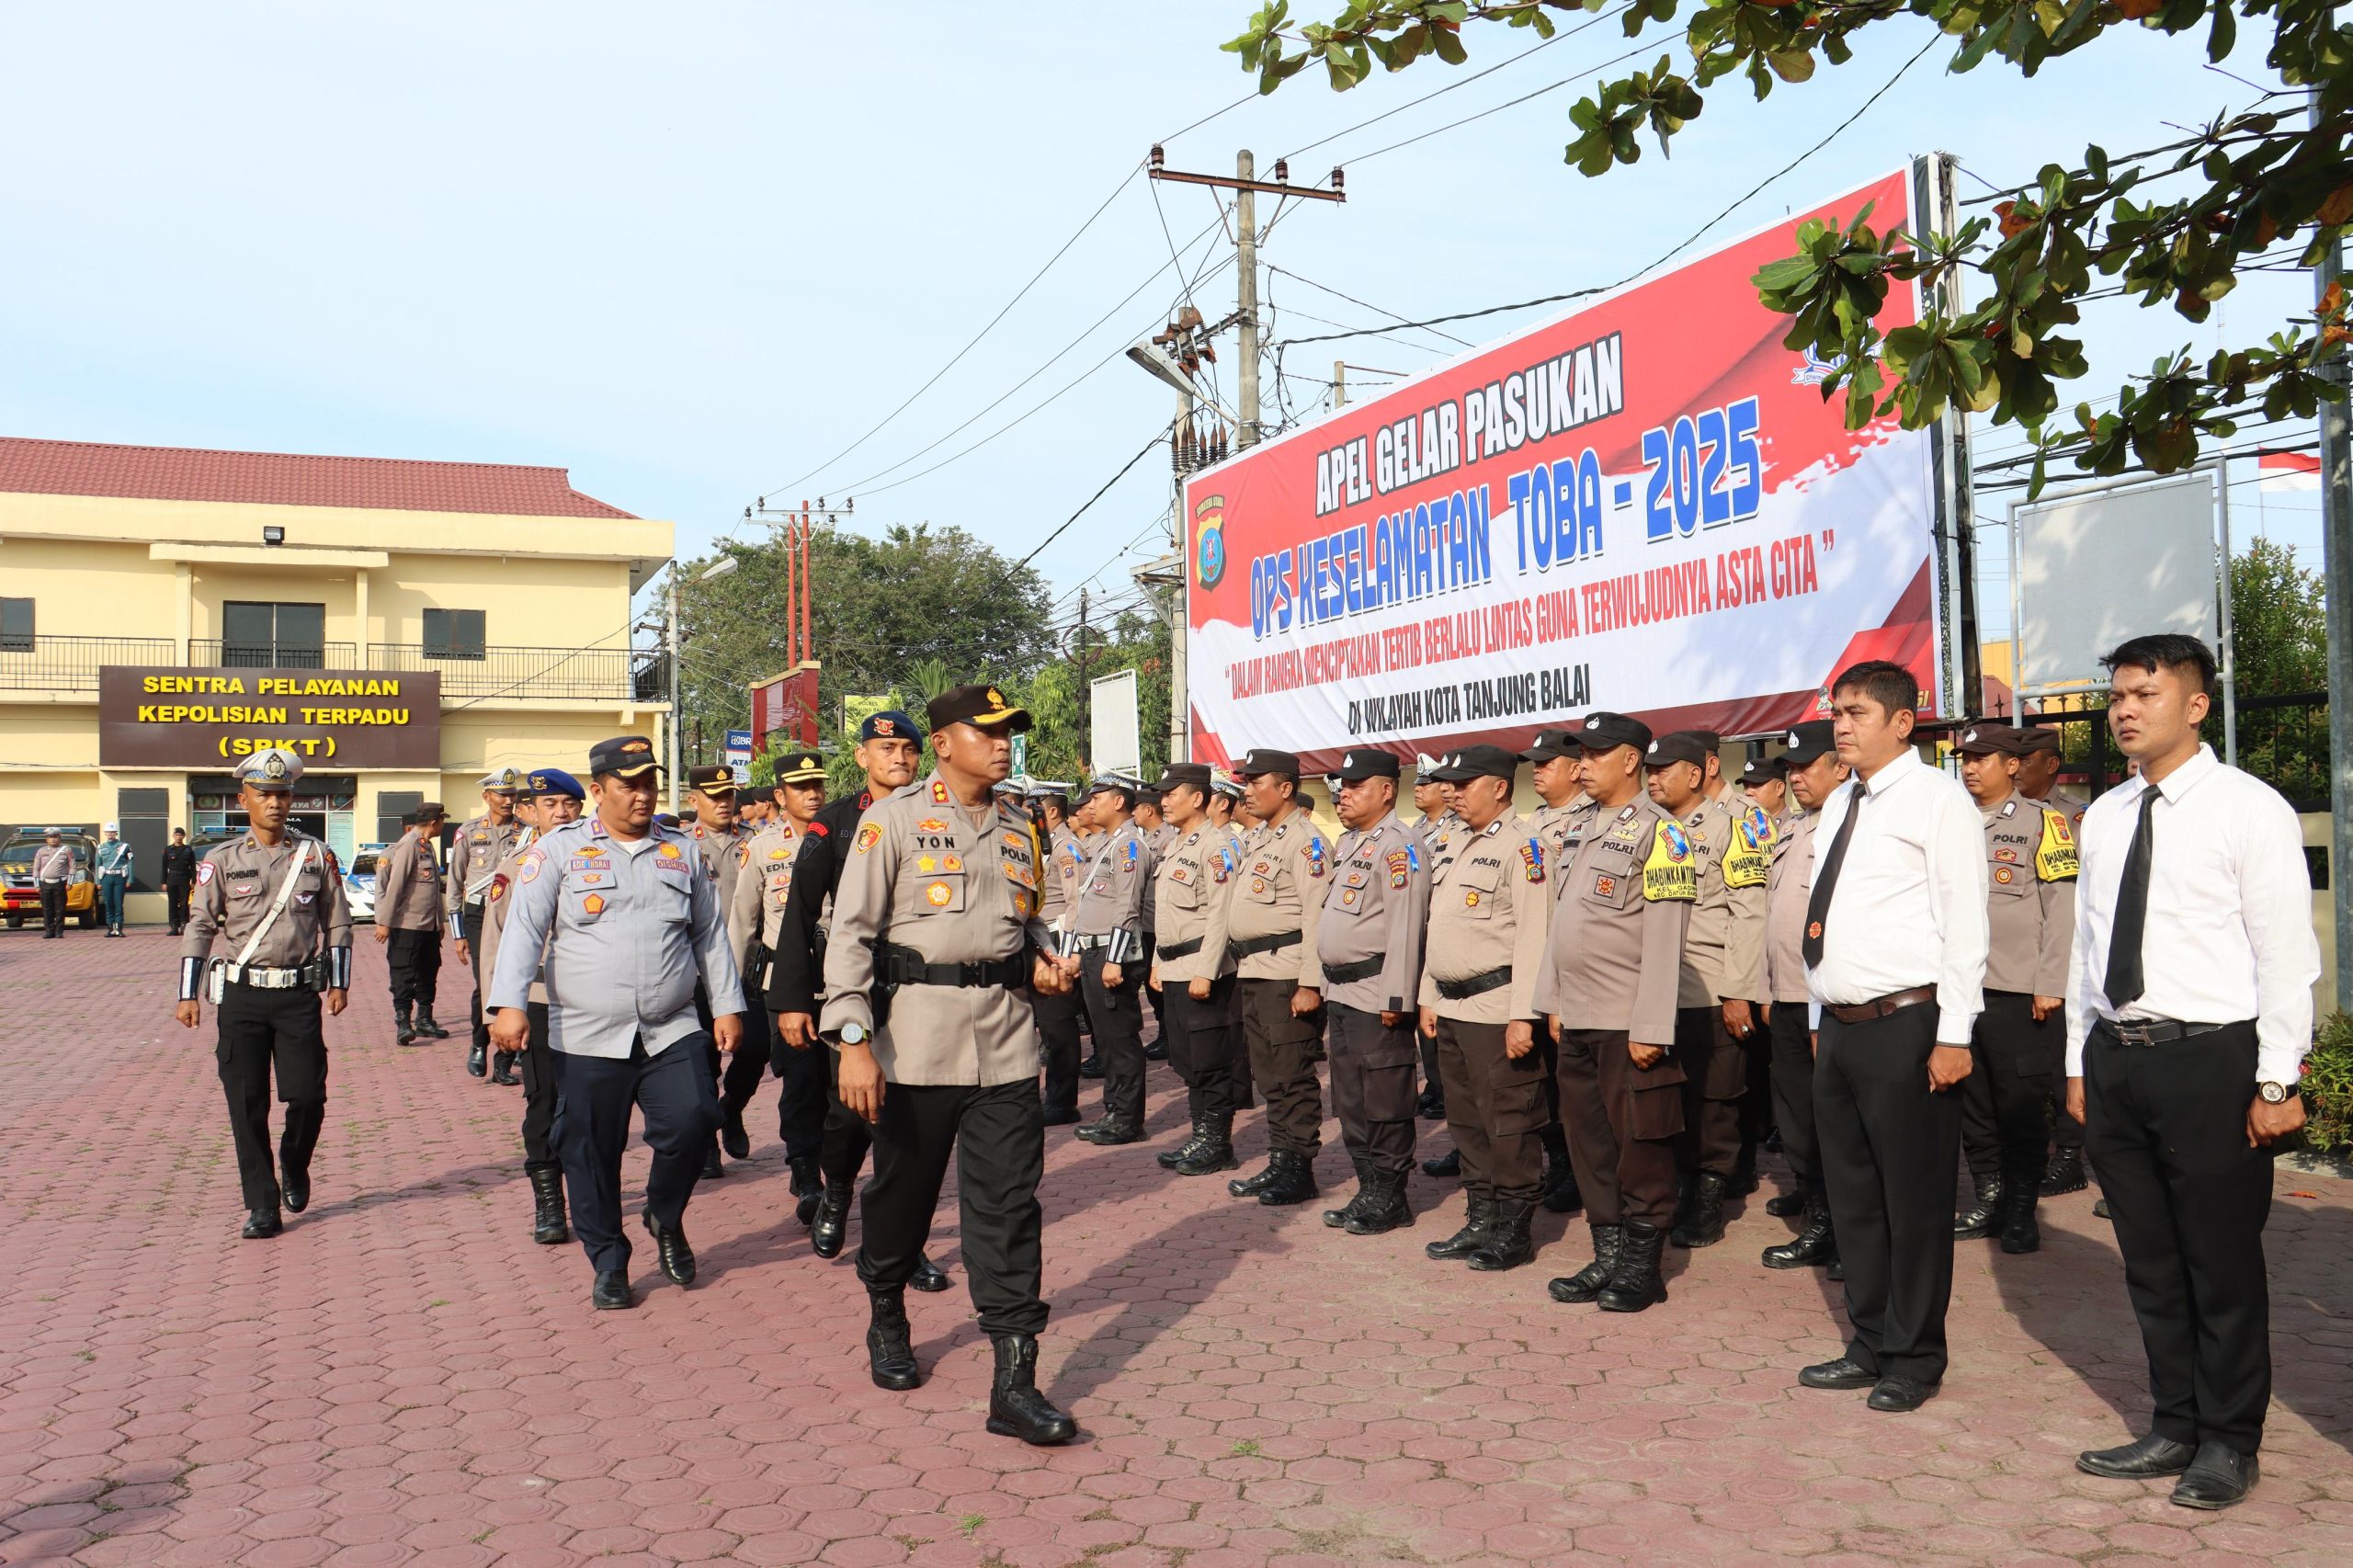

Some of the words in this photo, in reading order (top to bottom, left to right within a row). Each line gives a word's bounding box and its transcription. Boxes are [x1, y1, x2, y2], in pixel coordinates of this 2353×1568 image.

[1316, 434, 1372, 517] APEL
[1375, 400, 1461, 494] GELAR
[1465, 331, 1624, 463] PASUKAN
[1250, 549, 1291, 642] OPS
[1298, 483, 1493, 627] KESELAMATAN
[1508, 447, 1604, 576] TOBA
[1642, 395, 1762, 544] 2025
[1232, 656, 1263, 700] DALAM
[1304, 631, 1381, 687] MENCIPTAKAN
[1382, 623, 1421, 673] TERTIB
[1425, 608, 1482, 665] BERLALU
[1484, 600, 1534, 654] LINTAS
[1536, 587, 1580, 644] GUNA
[1582, 558, 1711, 636] TERWUJUDNYA
[1716, 545, 1768, 610] ASTA
[1770, 533, 1819, 600] CITA
[143, 676, 244, 694] SENTRA
[258, 678, 400, 697] PELAYANAN
[1348, 701, 1362, 735] DI
[1364, 690, 1423, 733] WILAYAH
[1425, 684, 1460, 726] KOTA
[1464, 672, 1536, 721] TANJUNG
[1540, 663, 1591, 710] BALAI
[138, 705, 287, 724] KEPOLISIAN
[301, 708, 410, 726] TERPADU
[915, 835, 956, 850] YON
[1600, 840, 1635, 856] POLRI
[1993, 834, 2029, 845] POLRI
[1000, 845, 1031, 867] POLRI
[1176, 857, 1199, 870] POLRI
[1350, 859, 1373, 871] POLRI
[1471, 857, 1502, 869] POLRI
